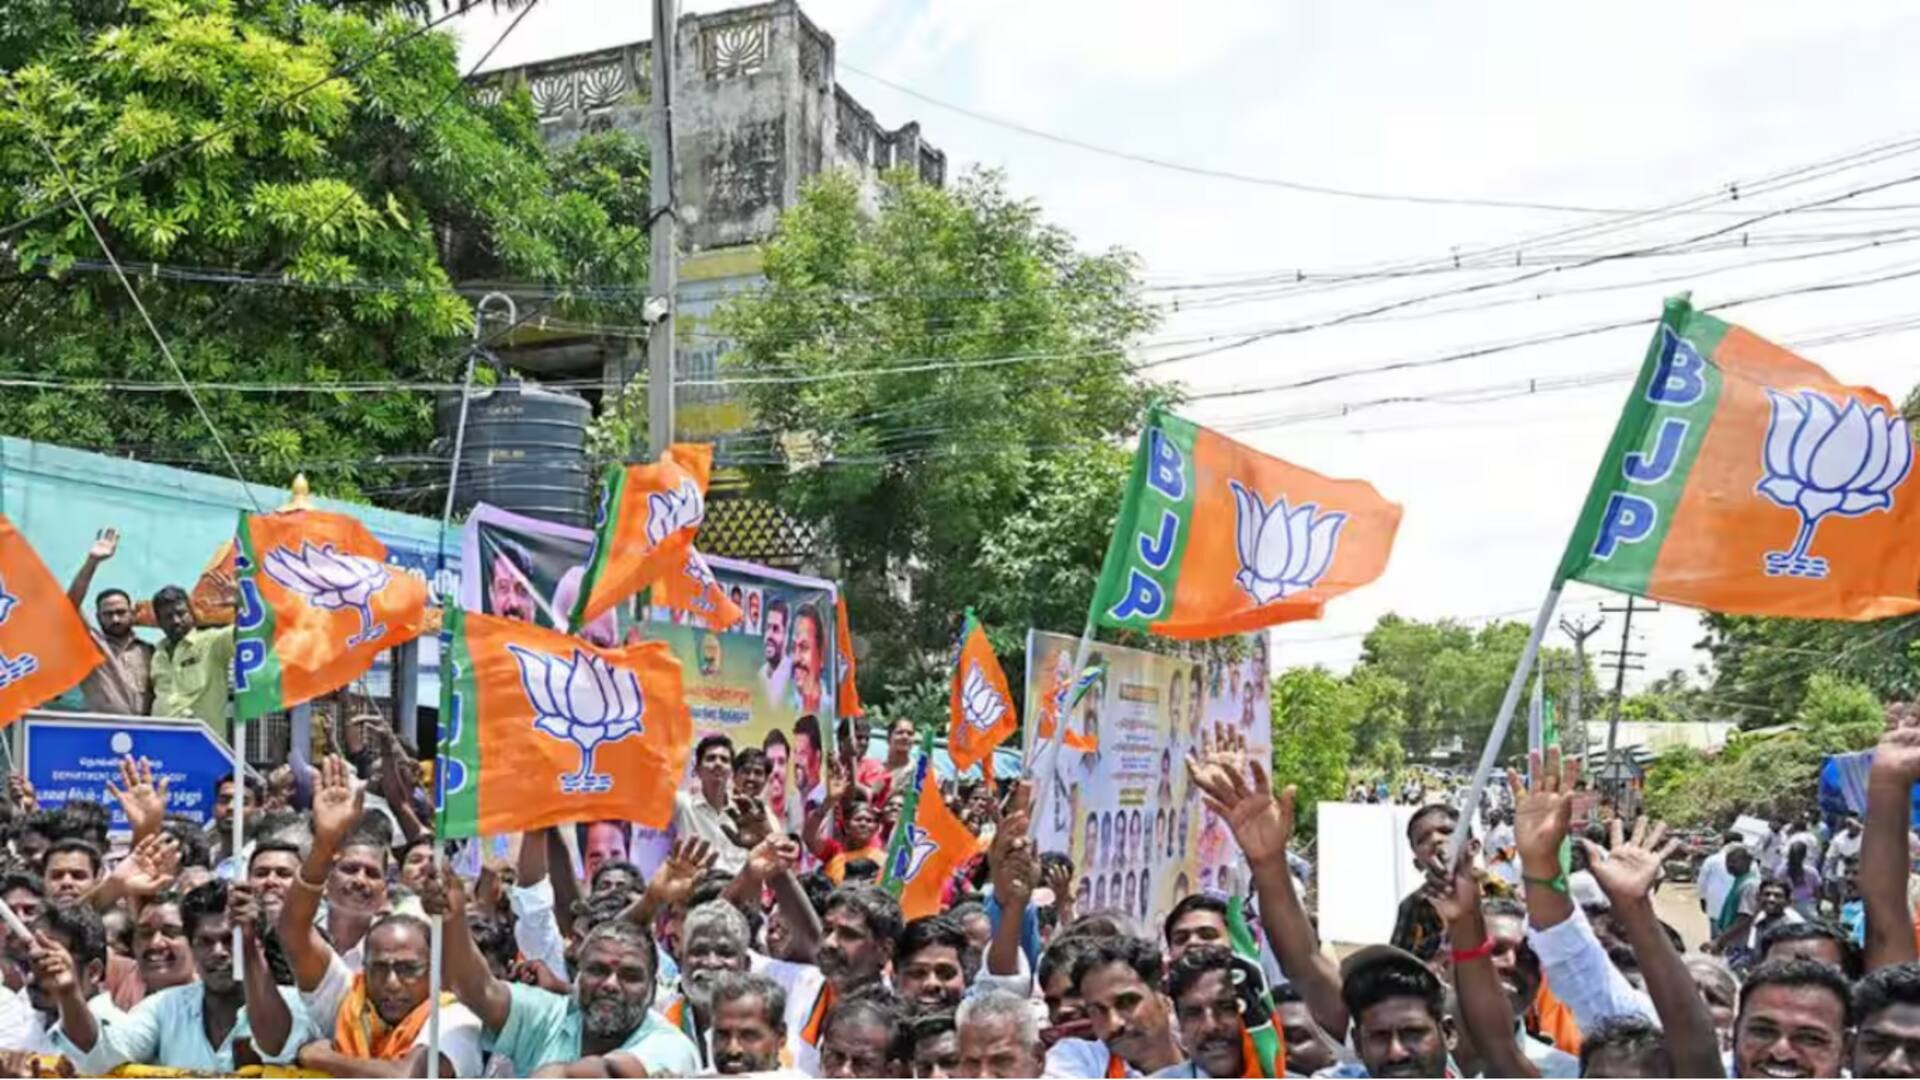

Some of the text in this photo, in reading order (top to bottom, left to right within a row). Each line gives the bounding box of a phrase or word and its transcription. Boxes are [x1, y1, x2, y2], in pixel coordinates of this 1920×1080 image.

[1107, 427, 1186, 620] BJP
[1590, 323, 1706, 562] BJP
[234, 537, 266, 692] JP
